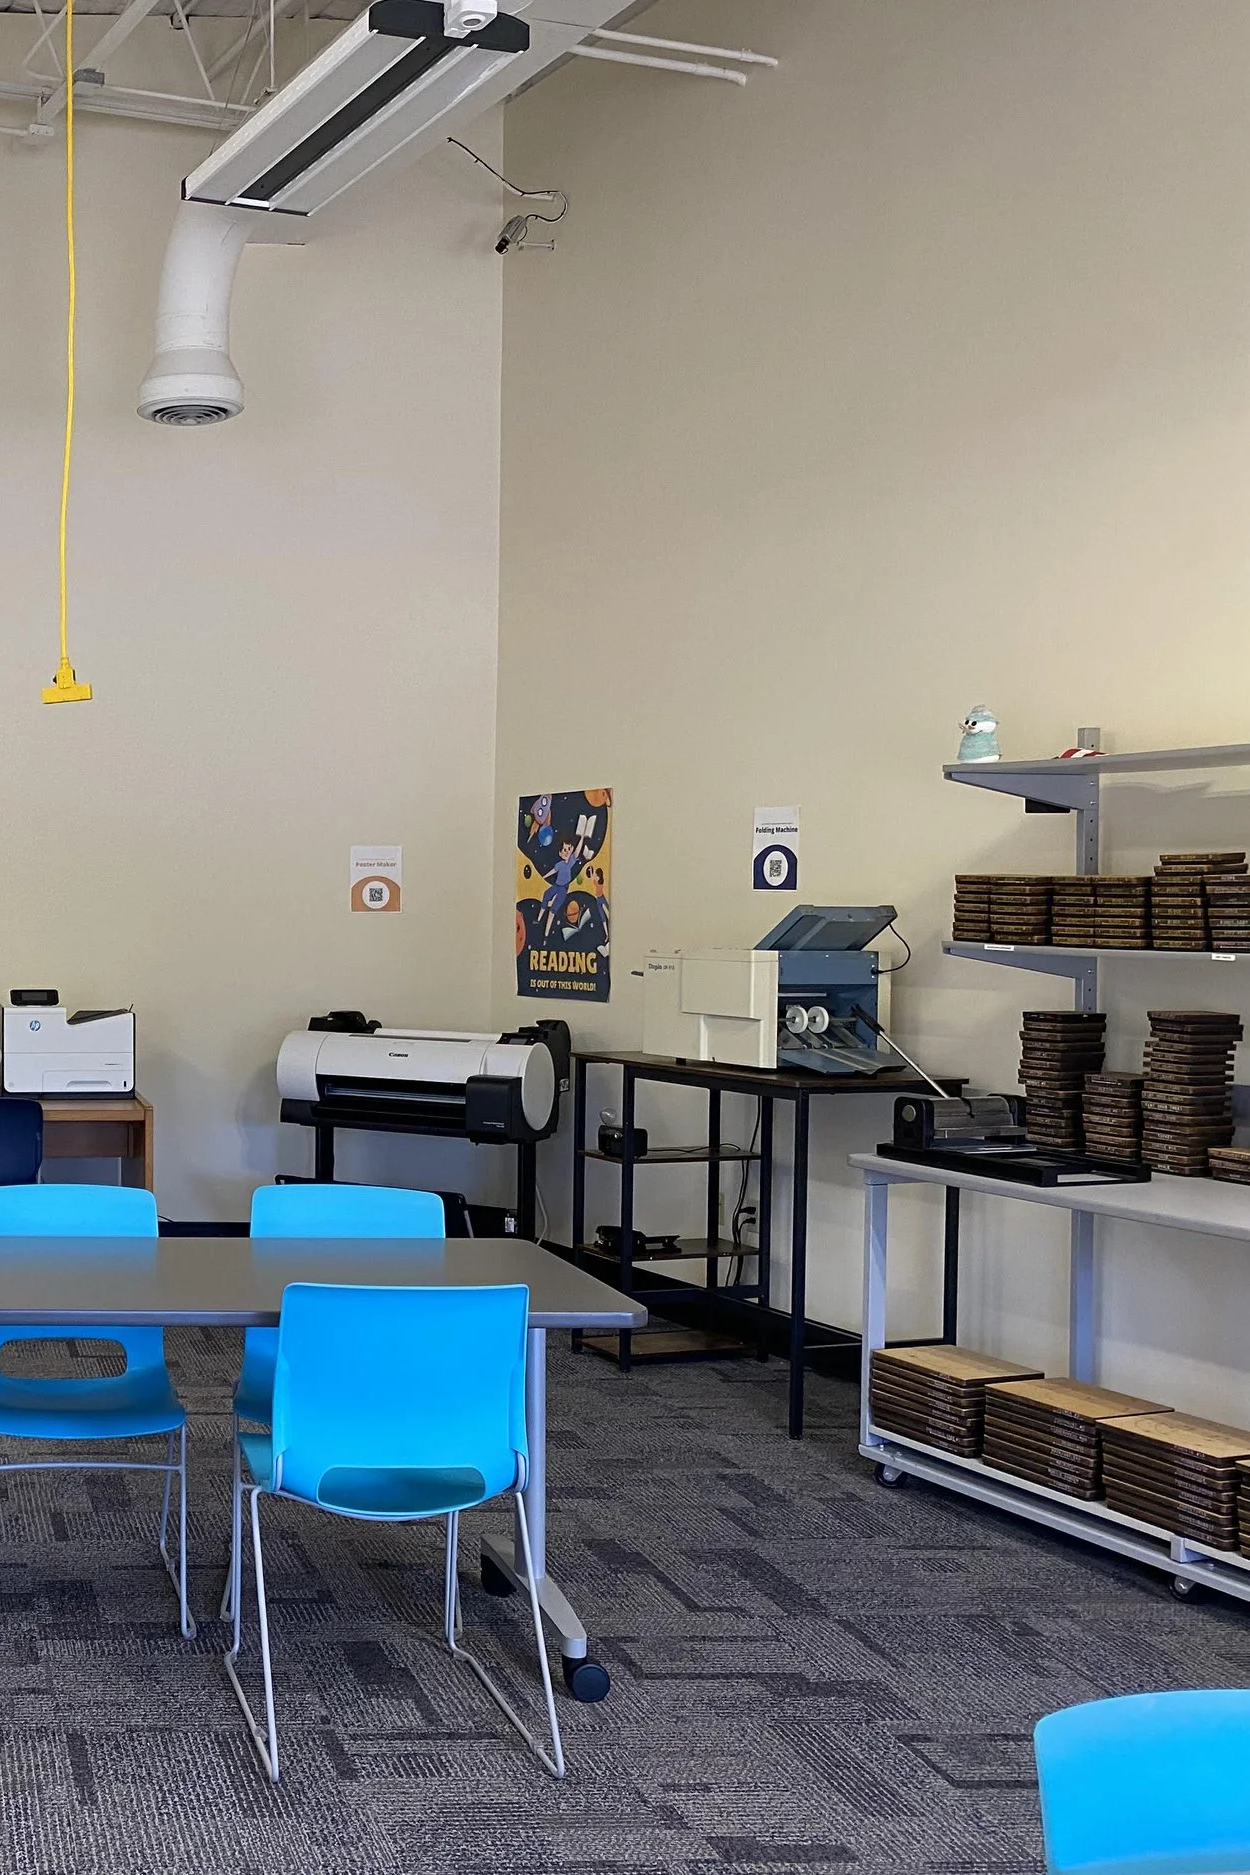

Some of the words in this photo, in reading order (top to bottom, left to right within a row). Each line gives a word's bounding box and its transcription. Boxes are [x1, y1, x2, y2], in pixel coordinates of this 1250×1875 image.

[530, 950, 598, 974] READING
[530, 980, 536, 988] IS
[537, 980, 550, 988] OUT
[550, 980, 558, 988] OF
[558, 981, 572, 990] THIS
[572, 982, 597, 992] WORLD!
